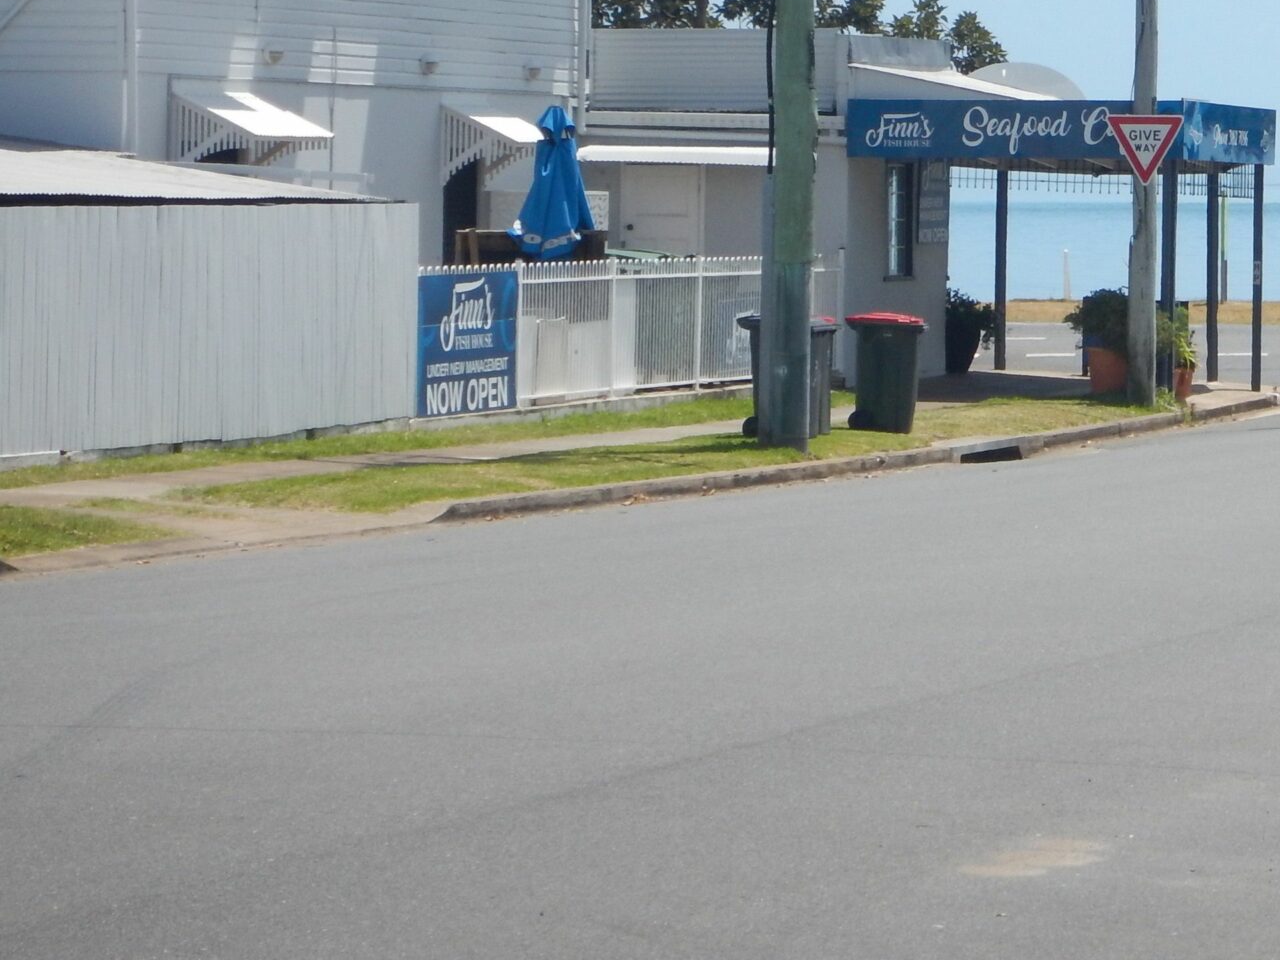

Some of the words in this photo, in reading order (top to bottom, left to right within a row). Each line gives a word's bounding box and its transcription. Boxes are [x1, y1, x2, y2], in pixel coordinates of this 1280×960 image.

[866, 112, 935, 147] Finn's
[962, 106, 1071, 155] Seafood
[1129, 130, 1161, 141] GIVE
[883, 139, 902, 147] FISH
[904, 139, 931, 147] HOUSE
[1134, 143, 1157, 152] WAY
[440, 277, 495, 352] Finn's
[455, 335, 470, 350] FISH
[471, 333, 494, 349] HOUSE
[427, 363, 450, 378] UNDER
[450, 361, 465, 376] NEW
[465, 357, 509, 374] MANAGEMENT
[426, 380, 465, 415] NOW
[467, 376, 508, 411] OPEN
